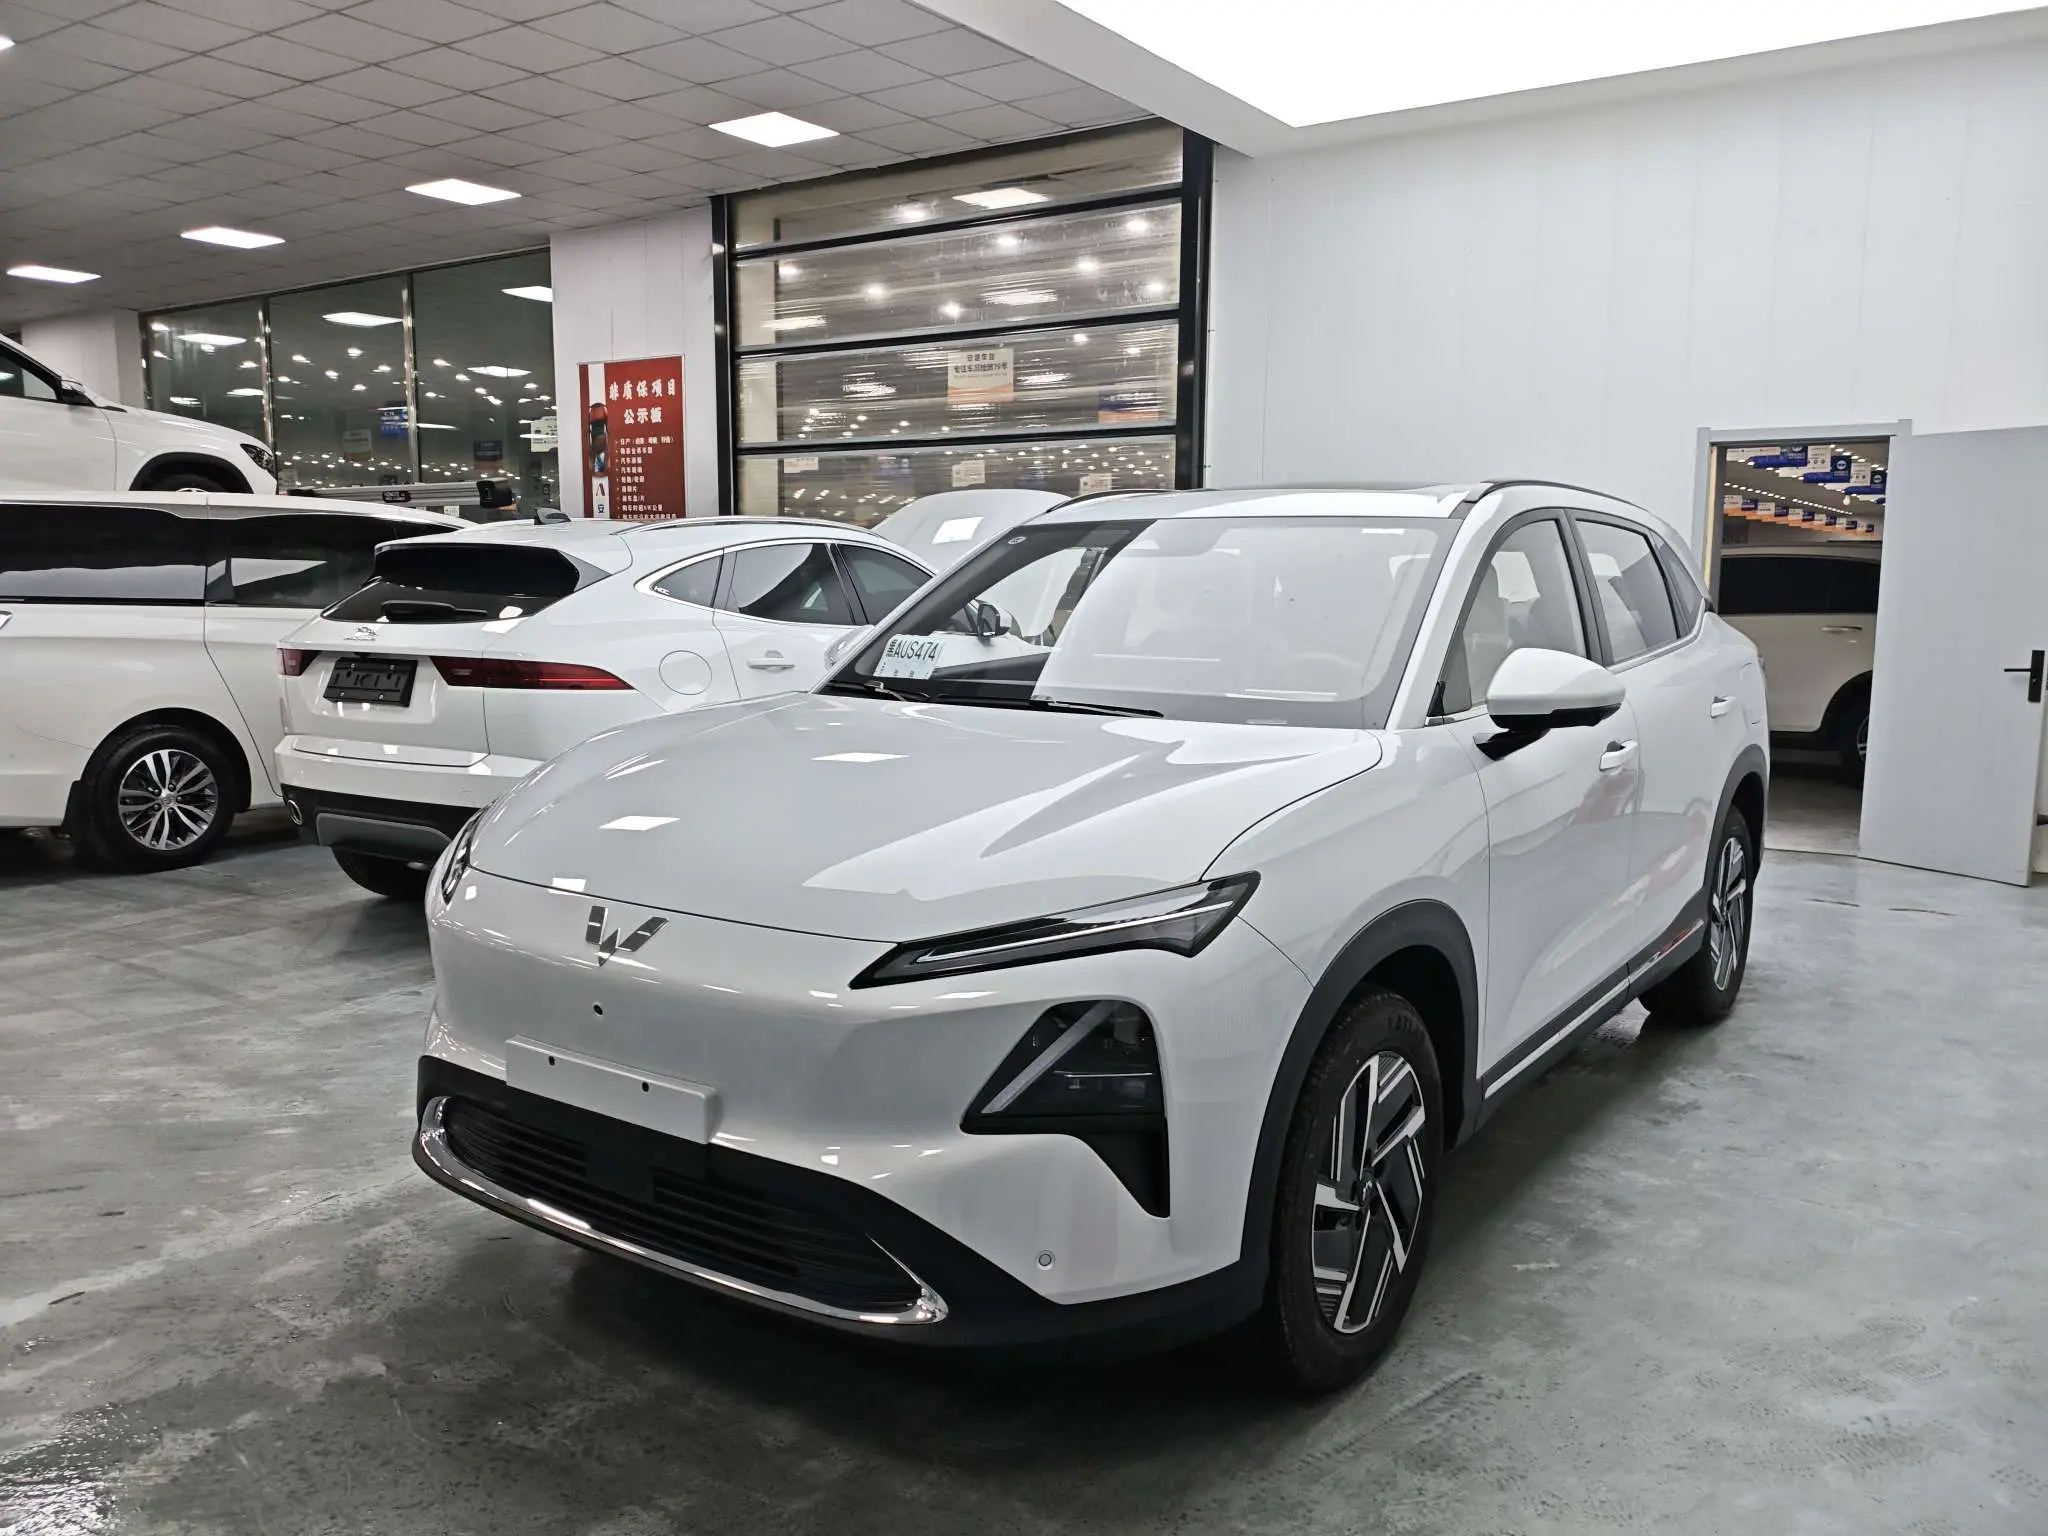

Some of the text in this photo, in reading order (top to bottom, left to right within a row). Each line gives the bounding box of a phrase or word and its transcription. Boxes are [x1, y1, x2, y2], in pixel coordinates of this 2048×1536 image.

[609, 378, 676, 400] 非质保项目
[624, 406, 662, 425] 公示板
